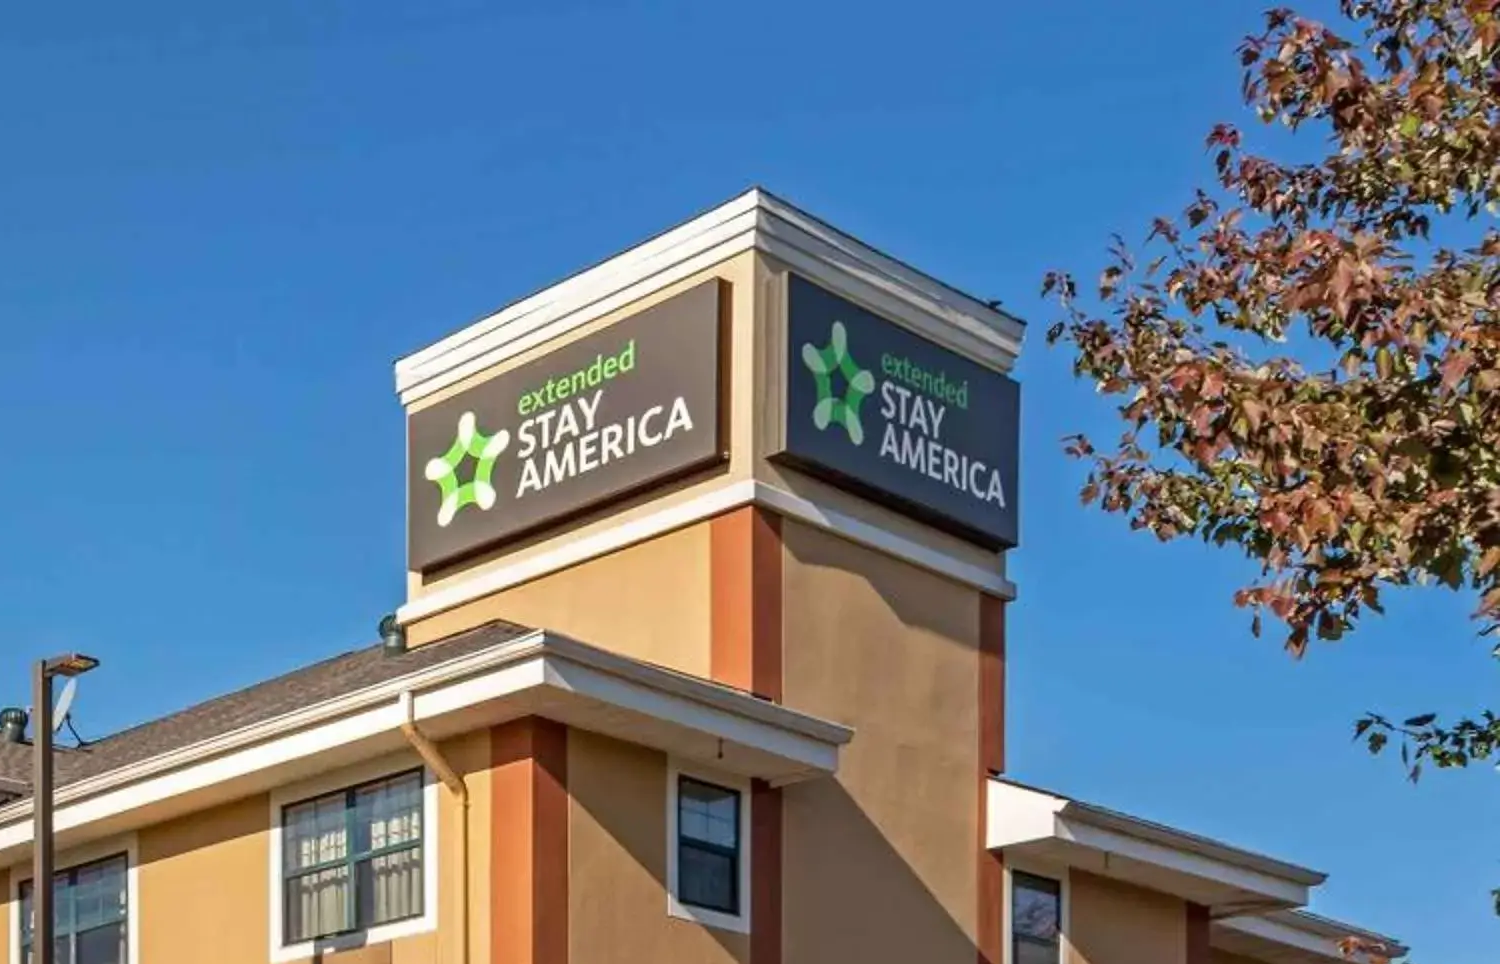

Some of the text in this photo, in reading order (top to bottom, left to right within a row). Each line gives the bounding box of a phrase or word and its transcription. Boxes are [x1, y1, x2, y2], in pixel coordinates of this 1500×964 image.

[517, 339, 636, 415] extended
[880, 378, 946, 439] STAY
[881, 352, 969, 409] extended
[515, 397, 694, 499] AMERICA
[517, 391, 604, 458] STAY
[880, 423, 1006, 508] AMERICA
